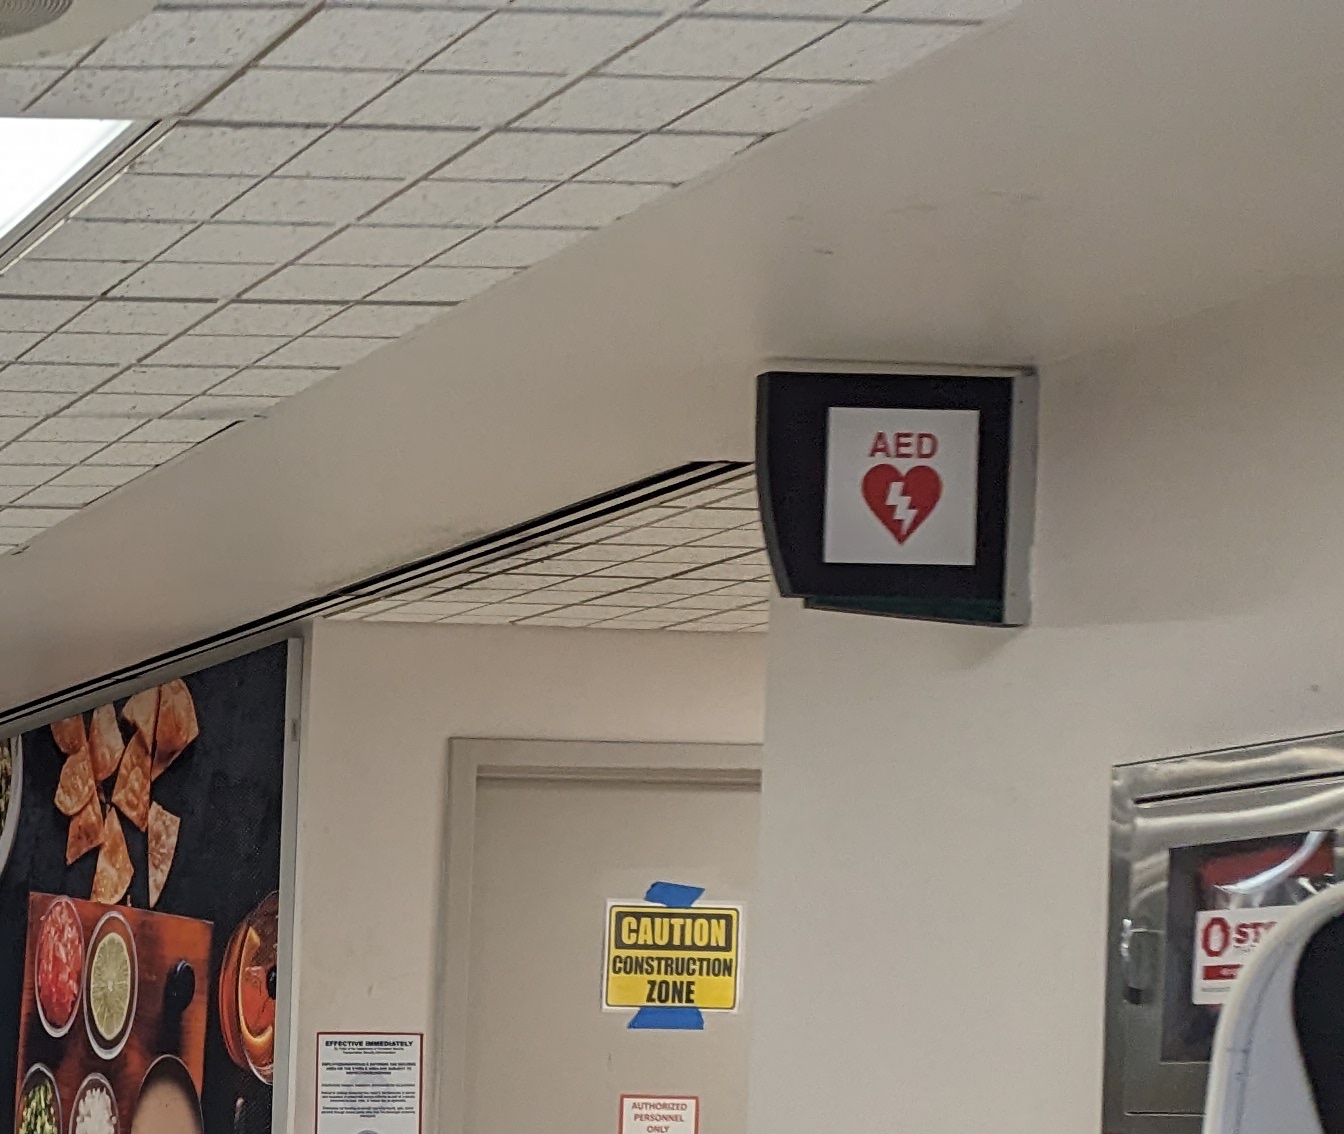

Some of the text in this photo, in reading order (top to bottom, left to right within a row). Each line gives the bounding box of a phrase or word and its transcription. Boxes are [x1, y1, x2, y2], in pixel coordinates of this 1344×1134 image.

[869, 431, 939, 459] AED
[621, 916, 726, 947] CAUTION
[612, 955, 733, 977] CONSTRUCTION
[646, 980, 696, 1004] ZONE
[632, 1102, 688, 1111] AUTHORIZED
[634, 1113, 684, 1122] PERSONNEL
[646, 1125, 670, 1133] ONLY
